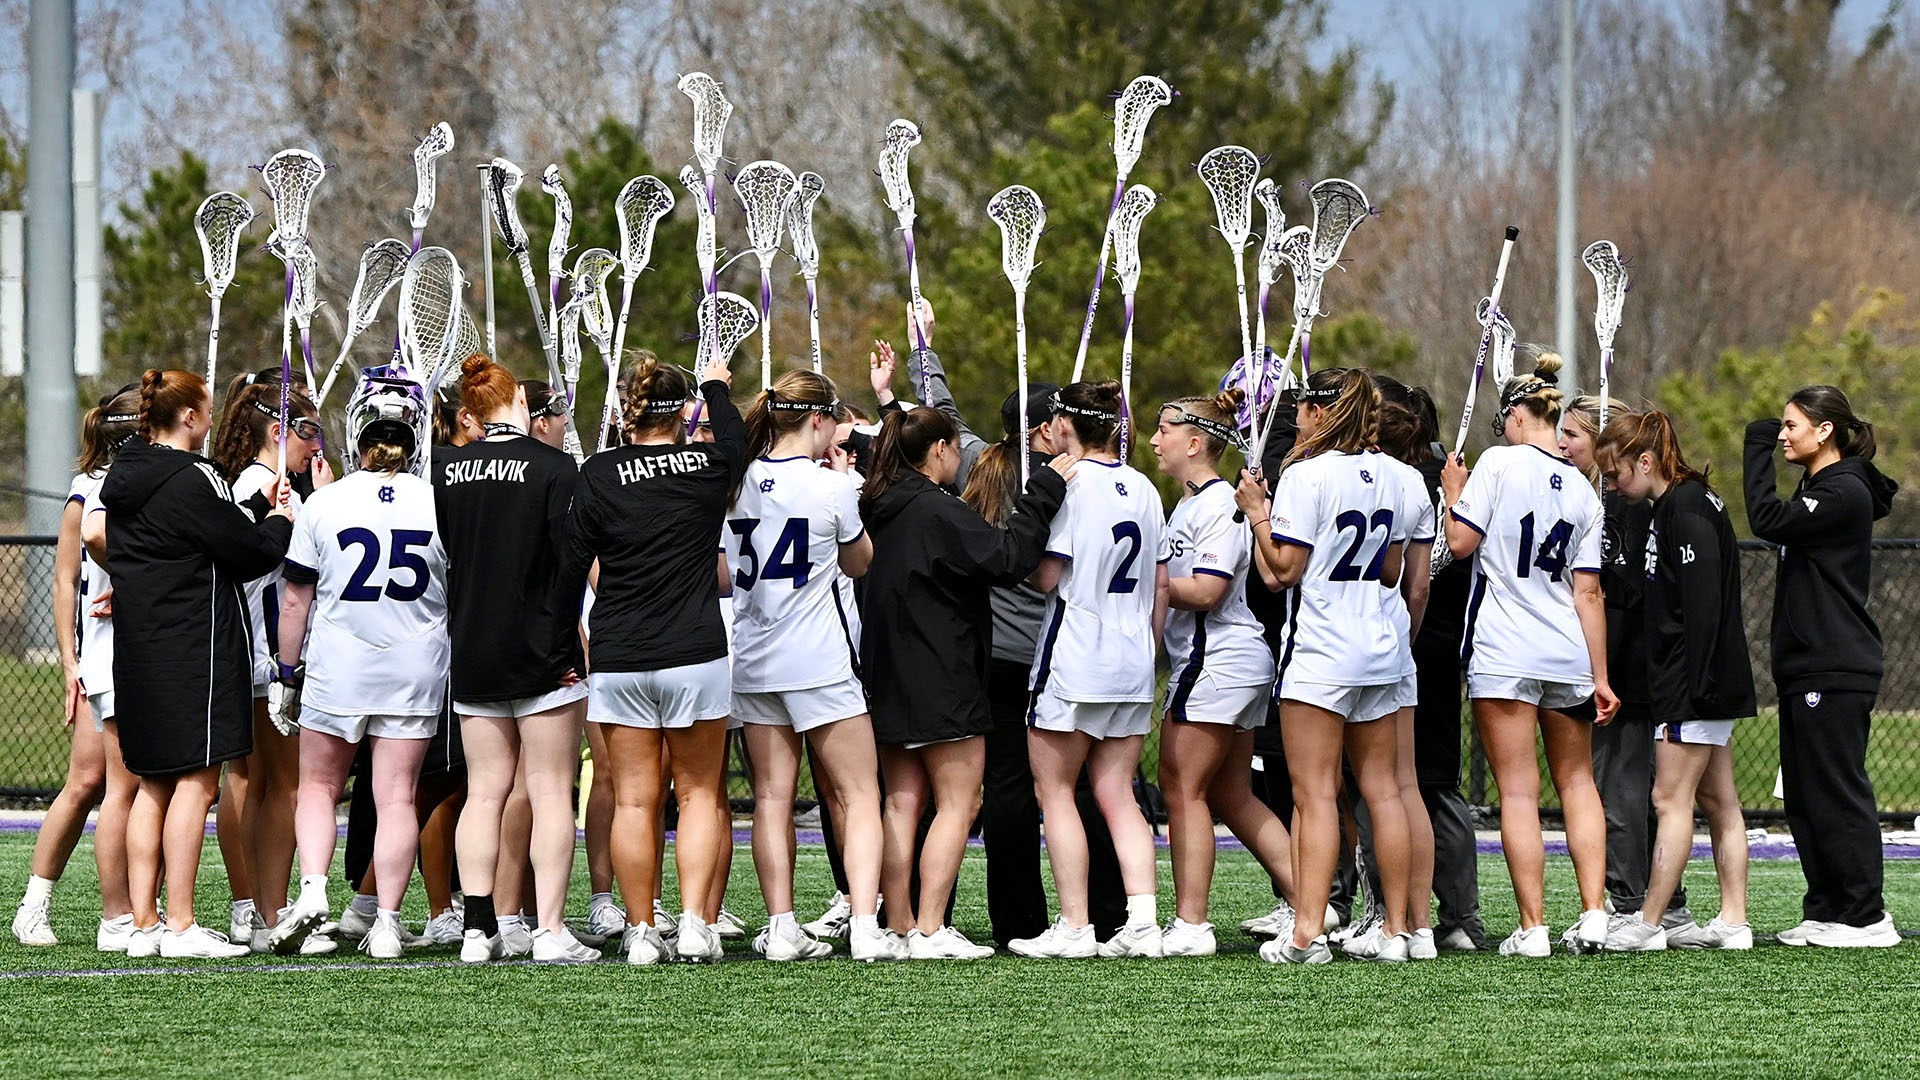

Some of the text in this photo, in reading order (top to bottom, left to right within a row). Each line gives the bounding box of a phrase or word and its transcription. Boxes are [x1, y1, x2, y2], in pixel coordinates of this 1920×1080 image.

[914, 286, 922, 310] GAIT
[539, 313, 548, 334] GAIT
[1085, 288, 1101, 340] HOLY CROSS
[811, 339, 819, 364] GAIT
[1477, 342, 1488, 366] HOLY
[1124, 352, 1132, 377] GAIT
[920, 350, 934, 405] HOLY CROSS
[1319, 388, 1336, 397] GAIT
[530, 406, 547, 418] GAIT
[1065, 405, 1079, 414] GAIT
[1185, 414, 1197, 422] AIT
[1198, 418, 1215, 427] GAIT
[1461, 404, 1472, 428] GAIT
[1119, 416, 1129, 465] HOLY CROS
[445, 459, 530, 487] SKULAVIK
[616, 451, 710, 486] HAFFNER
[727, 517, 815, 592] 34
[1107, 520, 1142, 594] 2
[1328, 509, 1394, 581] 22
[1516, 511, 1575, 583] 14
[1679, 543, 1695, 565] 26
[336, 526, 434, 602] 25
